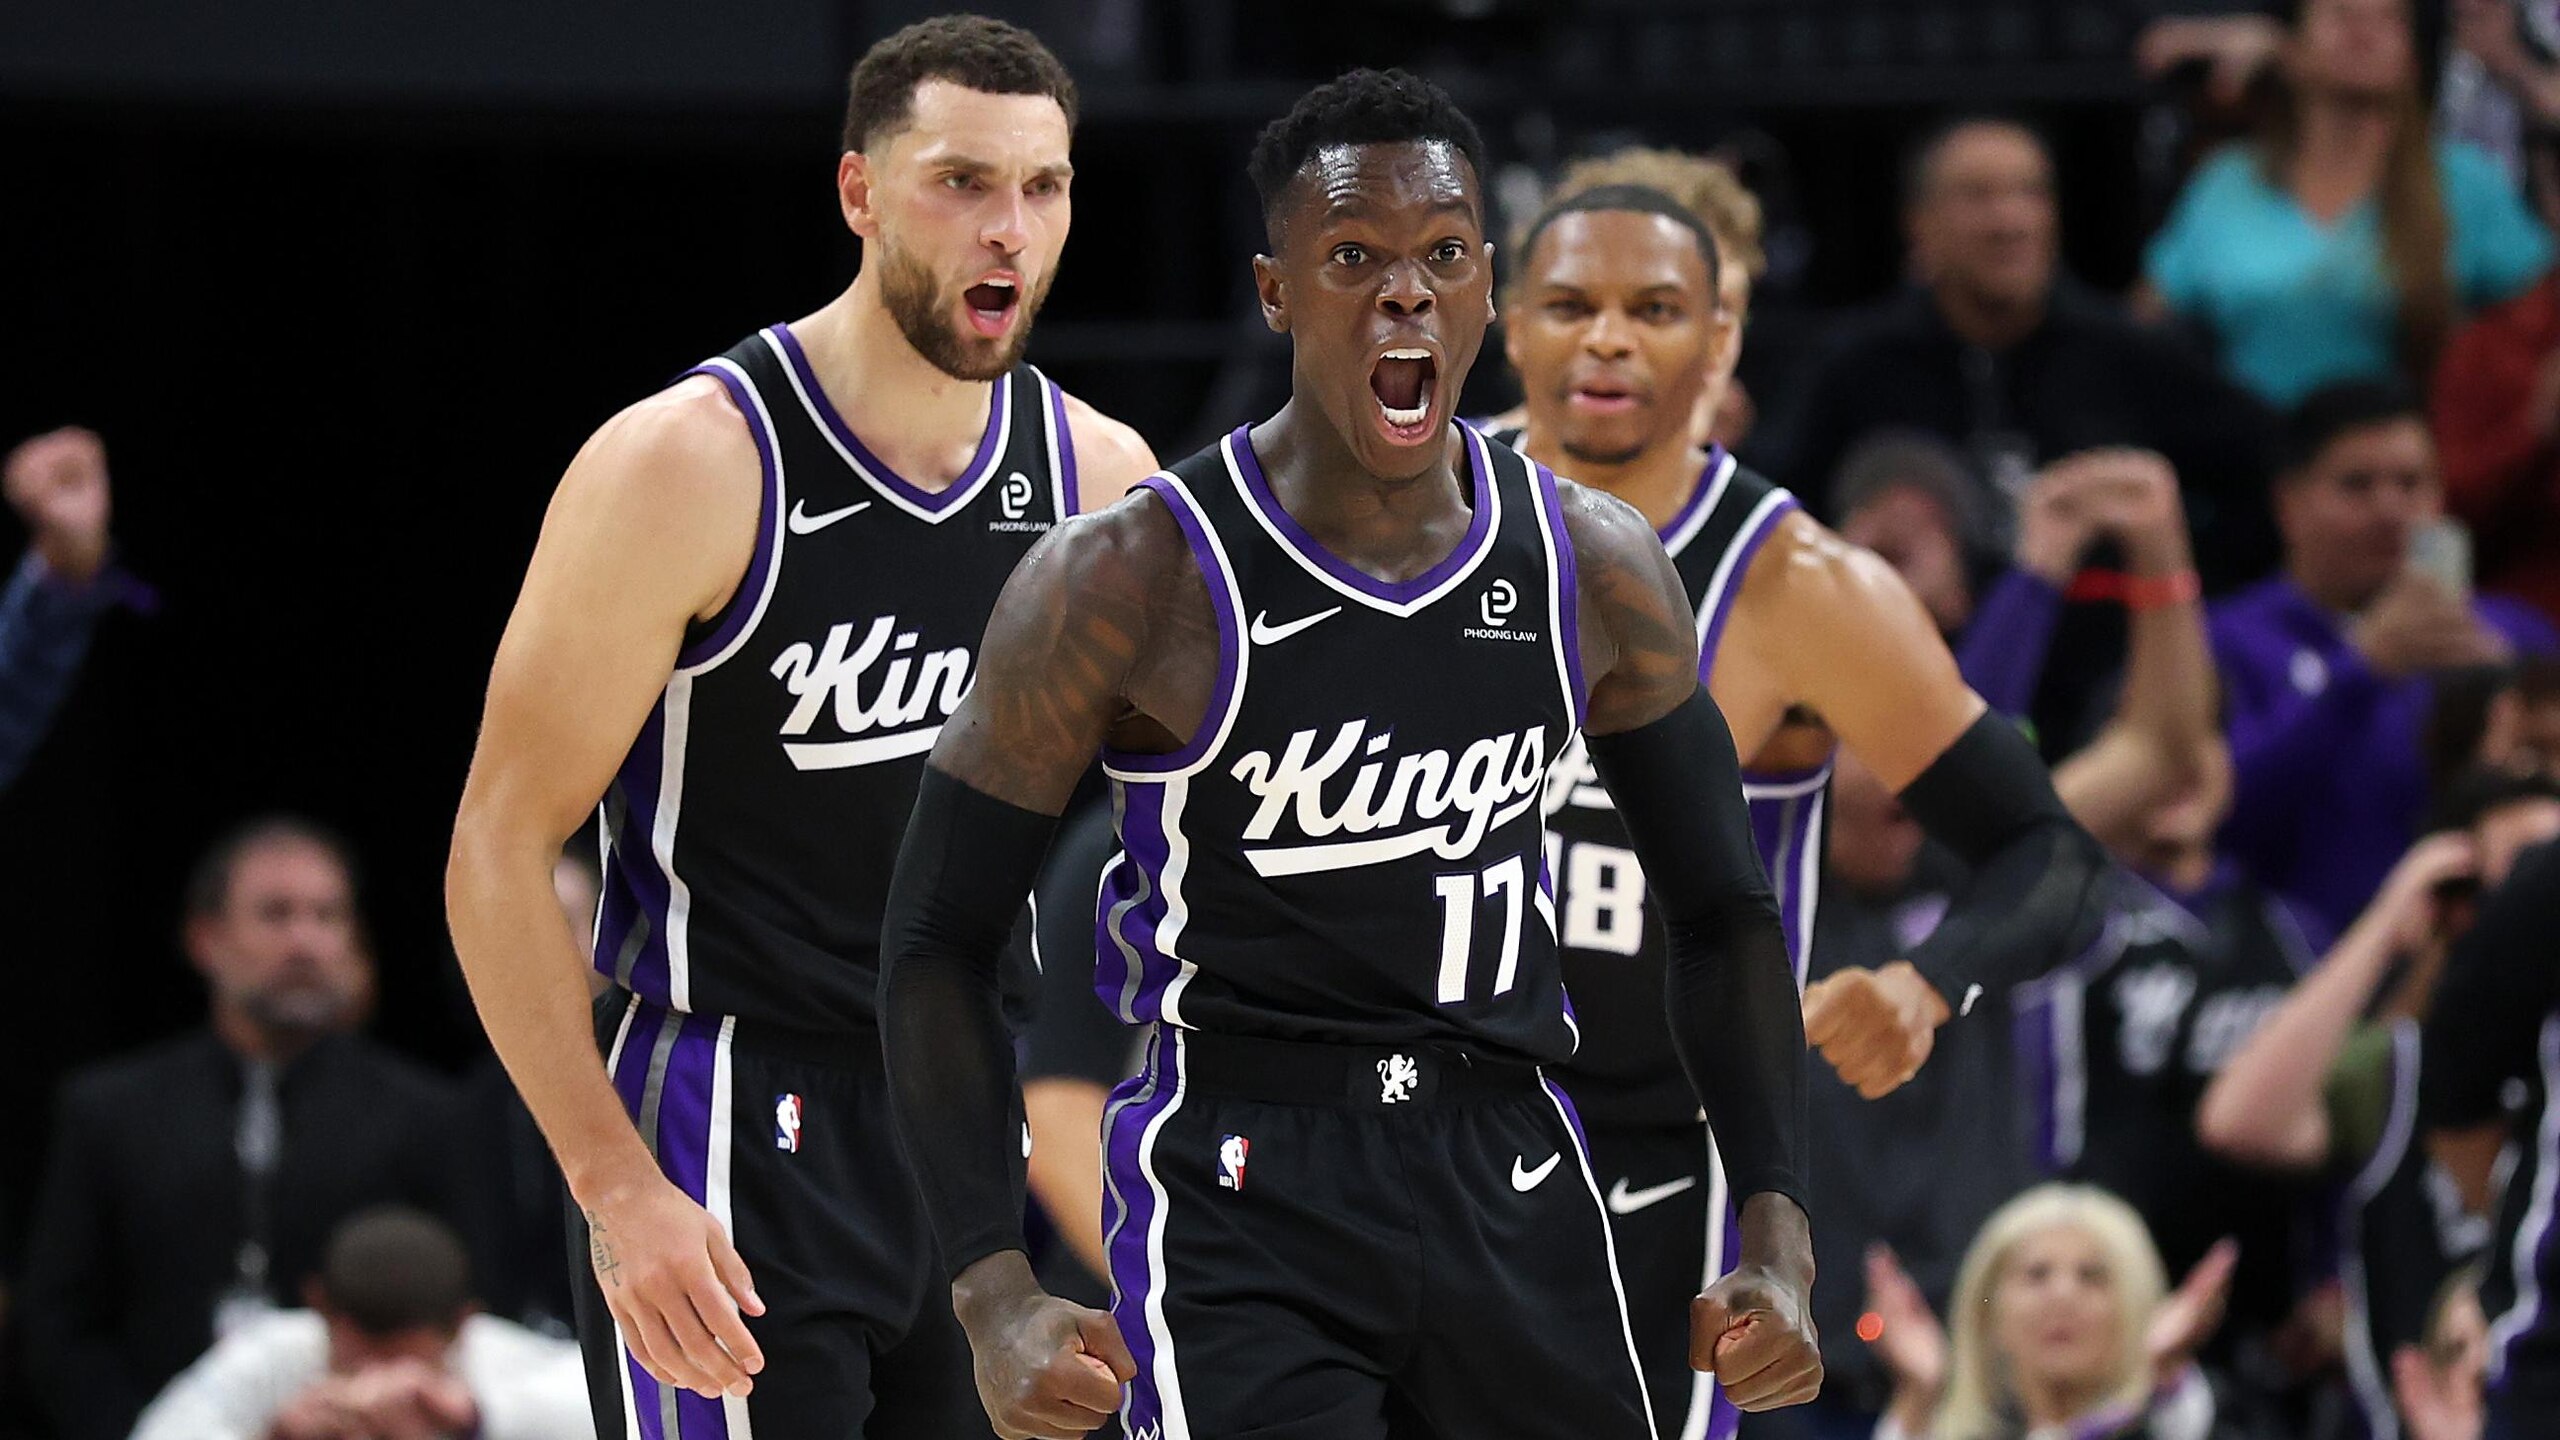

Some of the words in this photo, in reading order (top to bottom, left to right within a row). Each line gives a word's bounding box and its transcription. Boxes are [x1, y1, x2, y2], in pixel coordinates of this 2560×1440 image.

[769, 615, 976, 771] Kin
[1464, 628, 1511, 640] PHOONG
[1512, 631, 1537, 642] LAW
[1231, 719, 1544, 877] Kings
[1435, 854, 1524, 1005] 17
